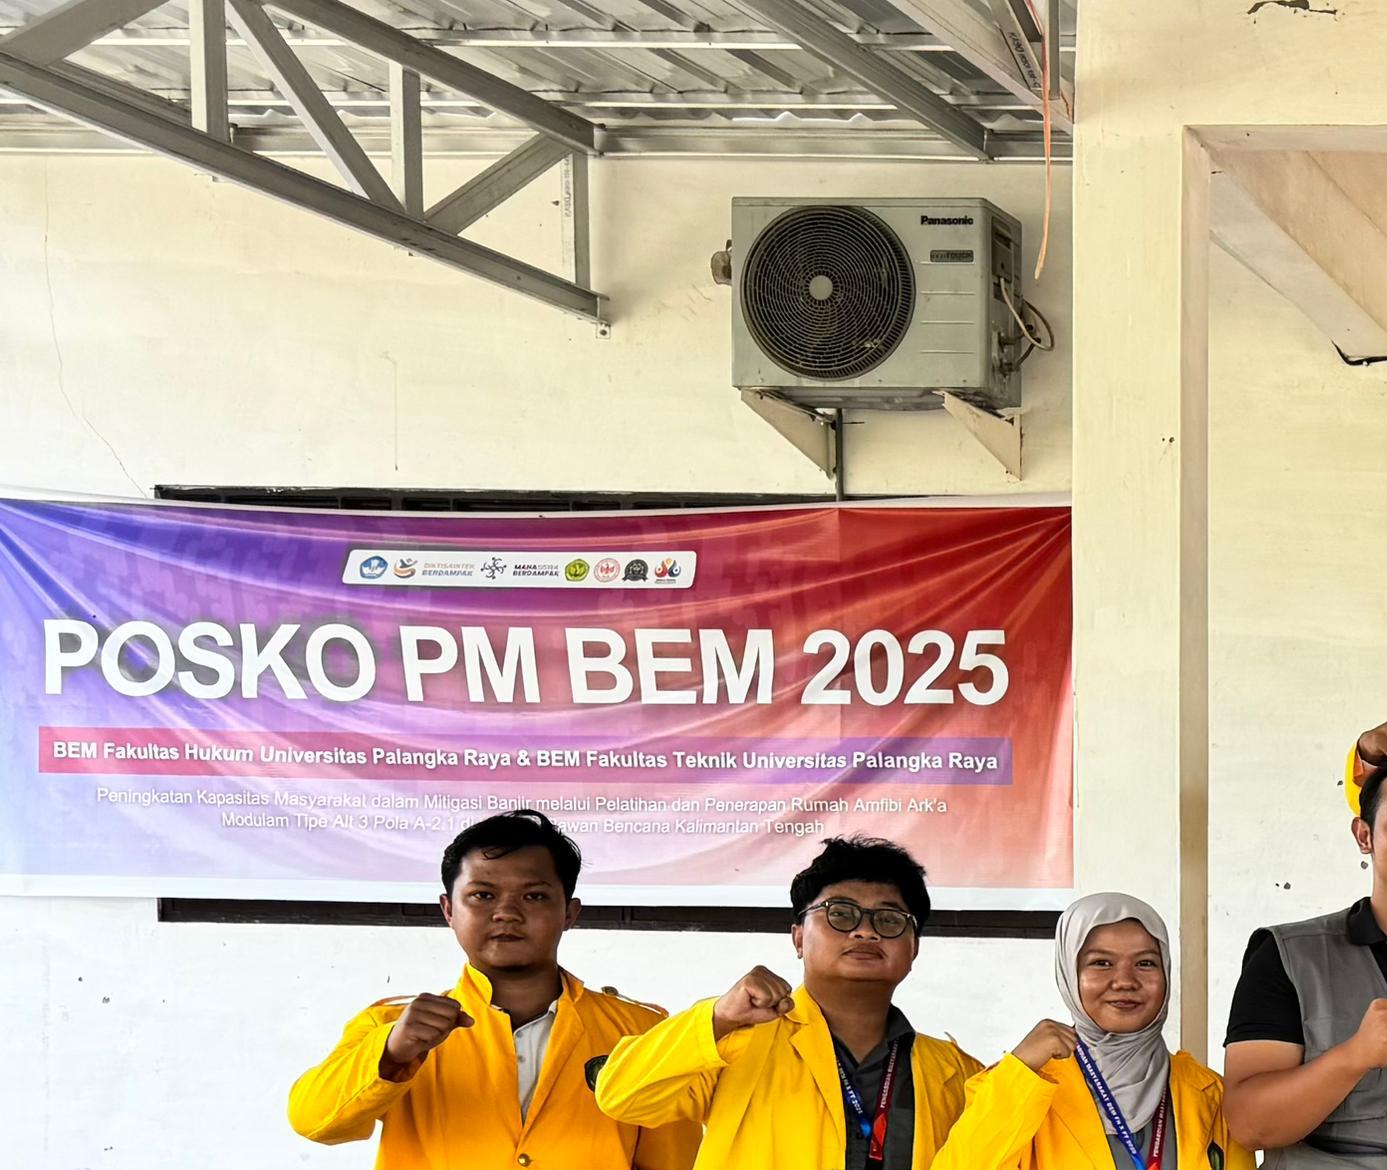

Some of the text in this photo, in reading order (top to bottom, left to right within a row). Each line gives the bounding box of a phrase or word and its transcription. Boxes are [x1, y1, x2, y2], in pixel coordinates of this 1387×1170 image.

[920, 215, 974, 225] Panasonic
[42, 618, 1010, 707] POSKO PM BEM 2025
[53, 741, 998, 773] BEM Fakultas Hukum Universitas Palangka Raya & BEM Fakultas Teknik Universitas Palangka Raya
[97, 787, 948, 816] Peningkatan Kapasitas Masyarakat dalam Mitigasi Banjir melalui Pelatihan dan Penerapan Rumah Amfibi Ark'a
[221, 811, 289, 828] Modulam
[294, 812, 328, 831] Tipe
[333, 813, 355, 829] Alt
[359, 814, 369, 829] 3
[373, 814, 409, 831] Pola
[413, 814, 455, 832] A-2.1
[602, 817, 670, 834] Bencana
[675, 818, 759, 834] Kalimantan
[764, 818, 824, 837] Tengah
